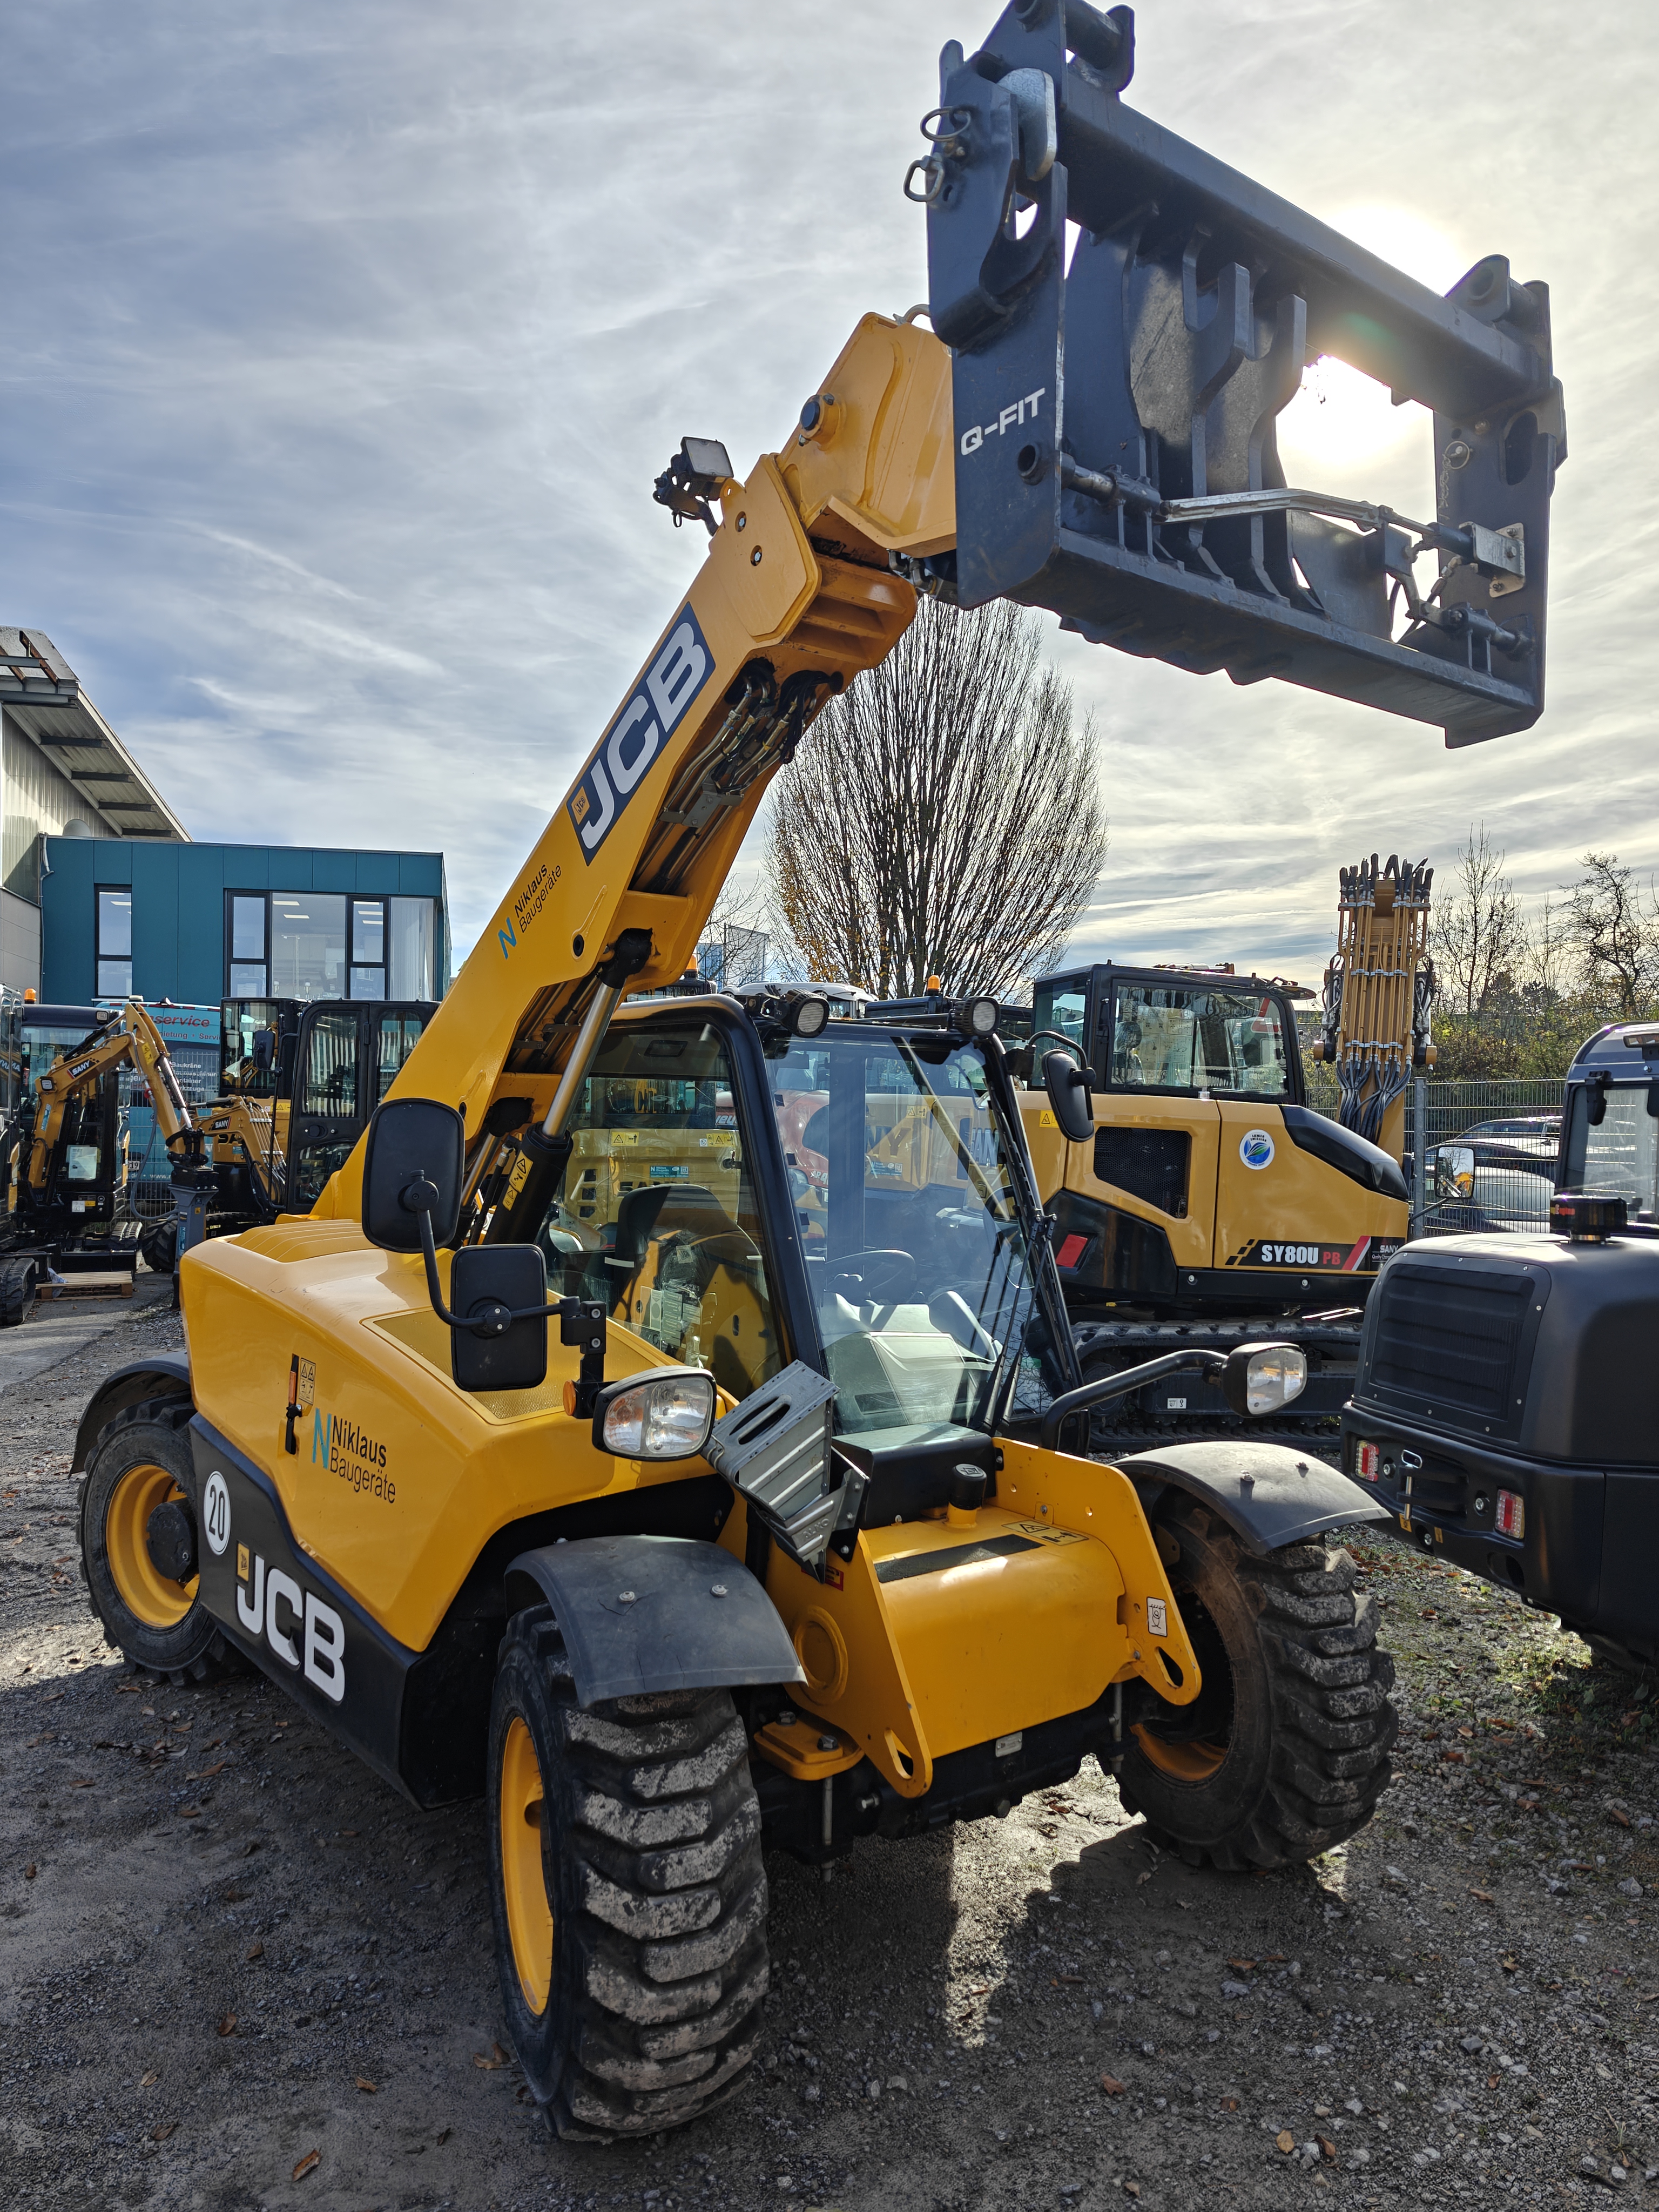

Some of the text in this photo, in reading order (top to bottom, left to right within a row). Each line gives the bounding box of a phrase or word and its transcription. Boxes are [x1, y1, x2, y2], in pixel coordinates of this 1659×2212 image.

[961, 387, 1046, 456] Q-FIT
[581, 622, 706, 849] JCB
[576, 798, 585, 813] JCB
[514, 864, 548, 915] Niklaus
[519, 865, 562, 933] Baugeräte
[150, 1015, 210, 1027] service
[72, 1060, 90, 1076] SANY
[215, 1120, 228, 1129] SANY
[1261, 1244, 1341, 1265] SY80U PB
[1379, 1245, 1399, 1253] SANY
[332, 1415, 387, 1468] Niklaus
[330, 1446, 396, 1504] Baugeräte
[208, 1485, 226, 1548] 20
[237, 1554, 345, 1702] JCB
